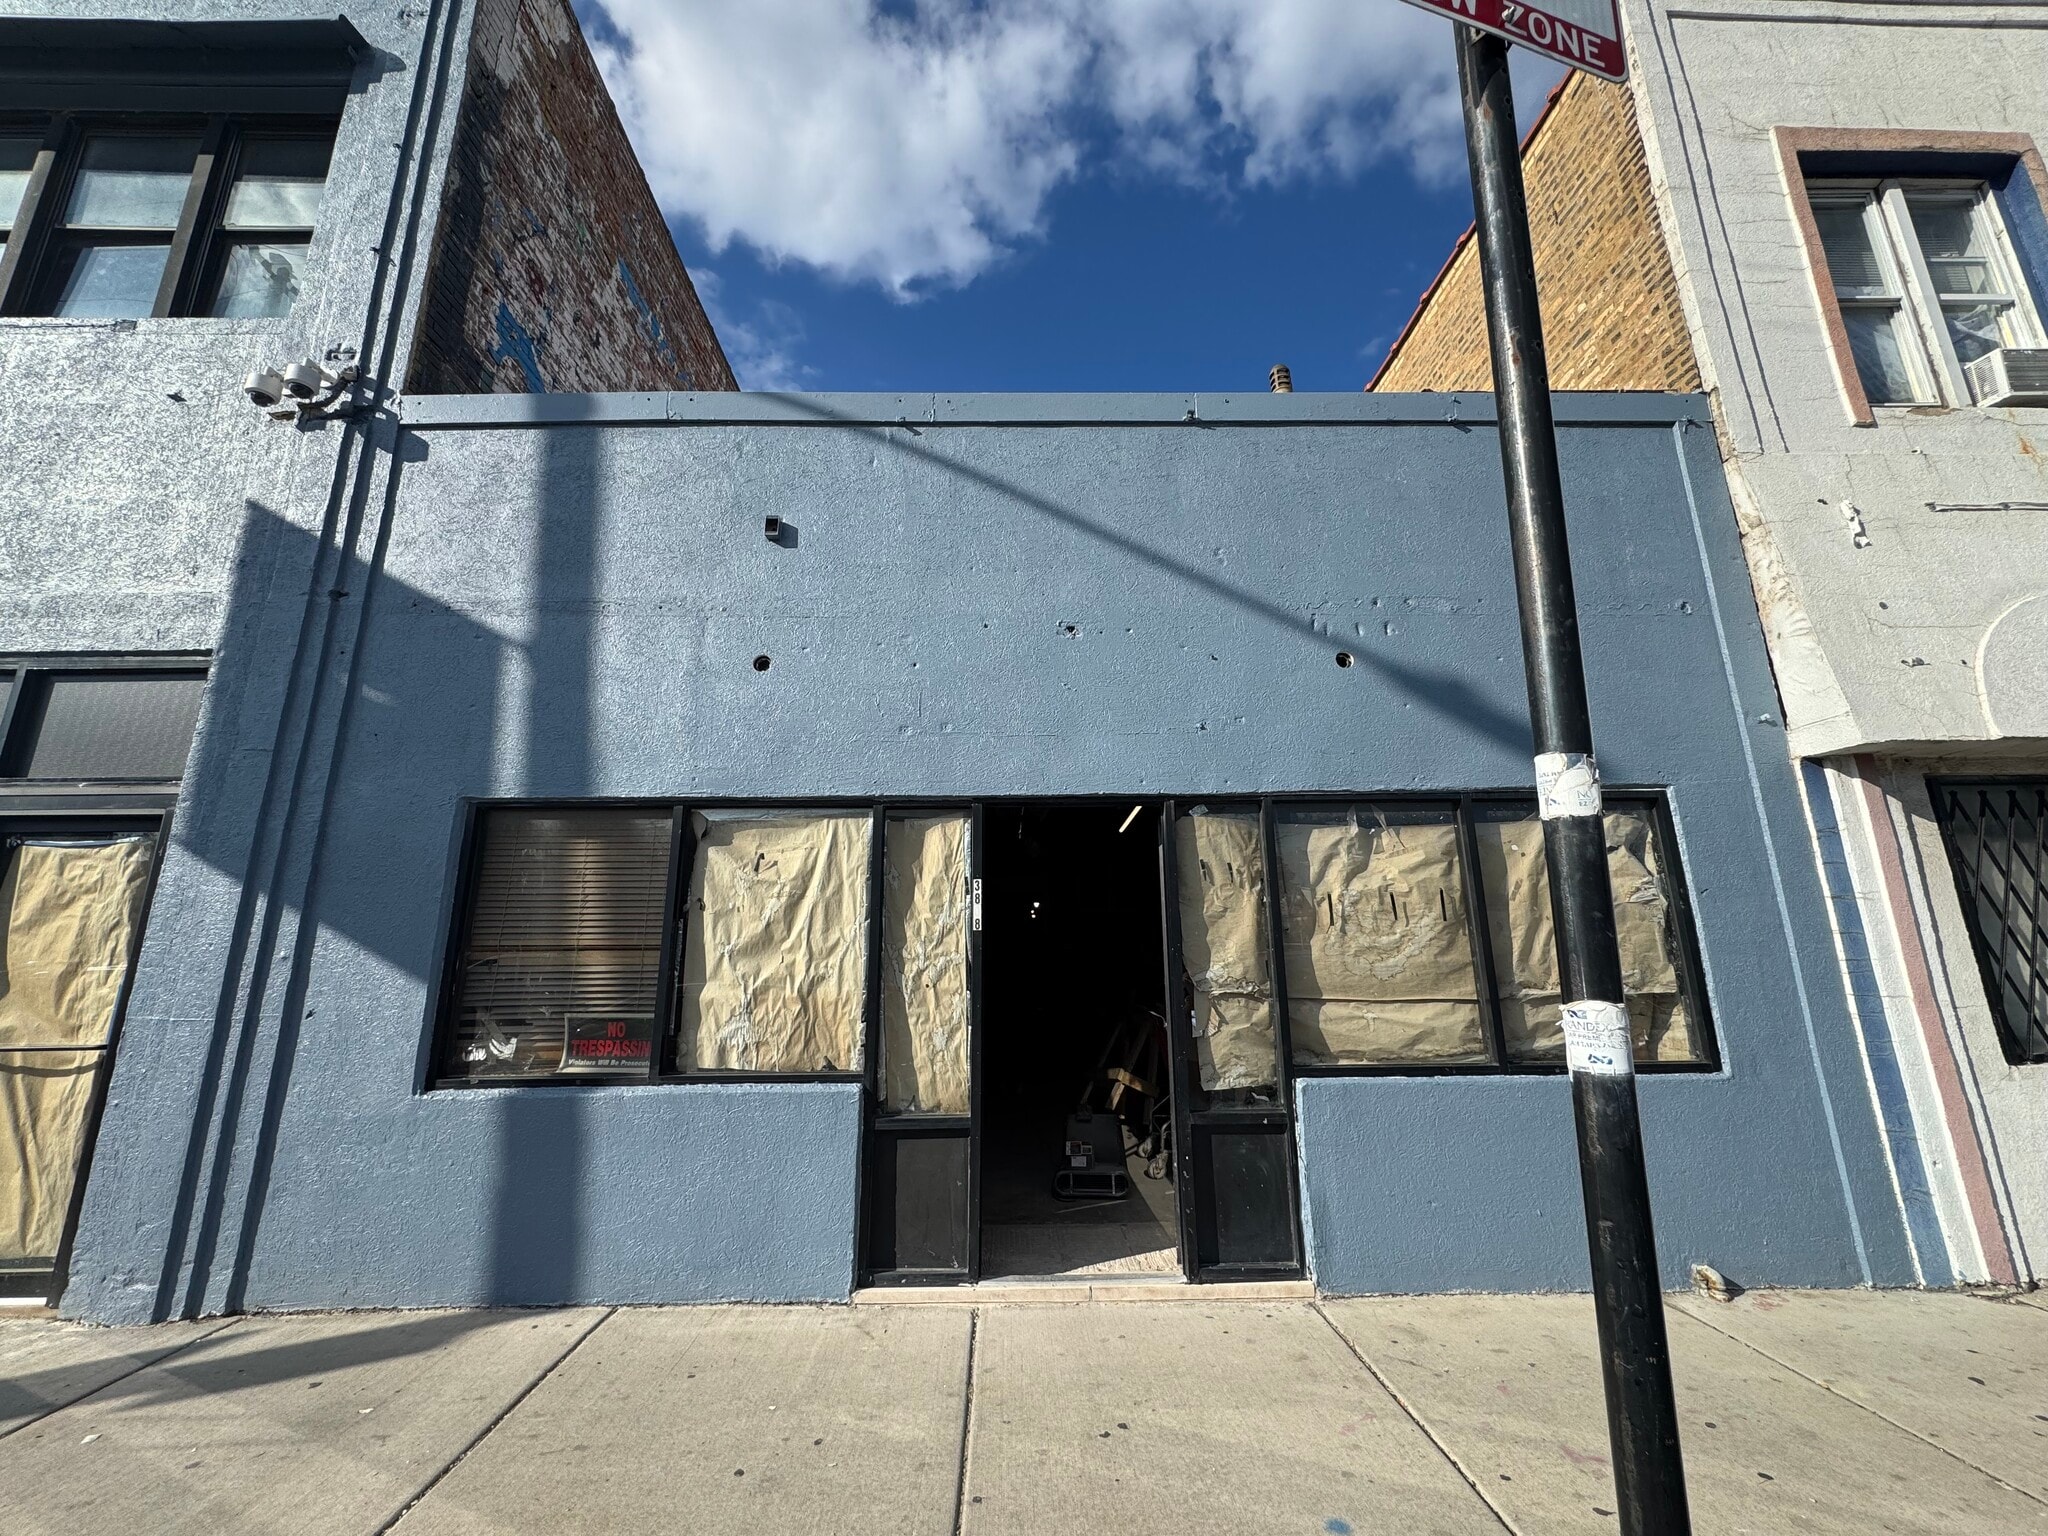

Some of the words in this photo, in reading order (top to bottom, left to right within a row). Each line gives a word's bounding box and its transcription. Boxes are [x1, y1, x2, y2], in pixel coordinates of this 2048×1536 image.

[1503, 2, 1605, 67] ZONE
[608, 1022, 625, 1037] NO
[572, 1040, 651, 1056] TRESPASSIN
[568, 1058, 596, 1066] Violators
